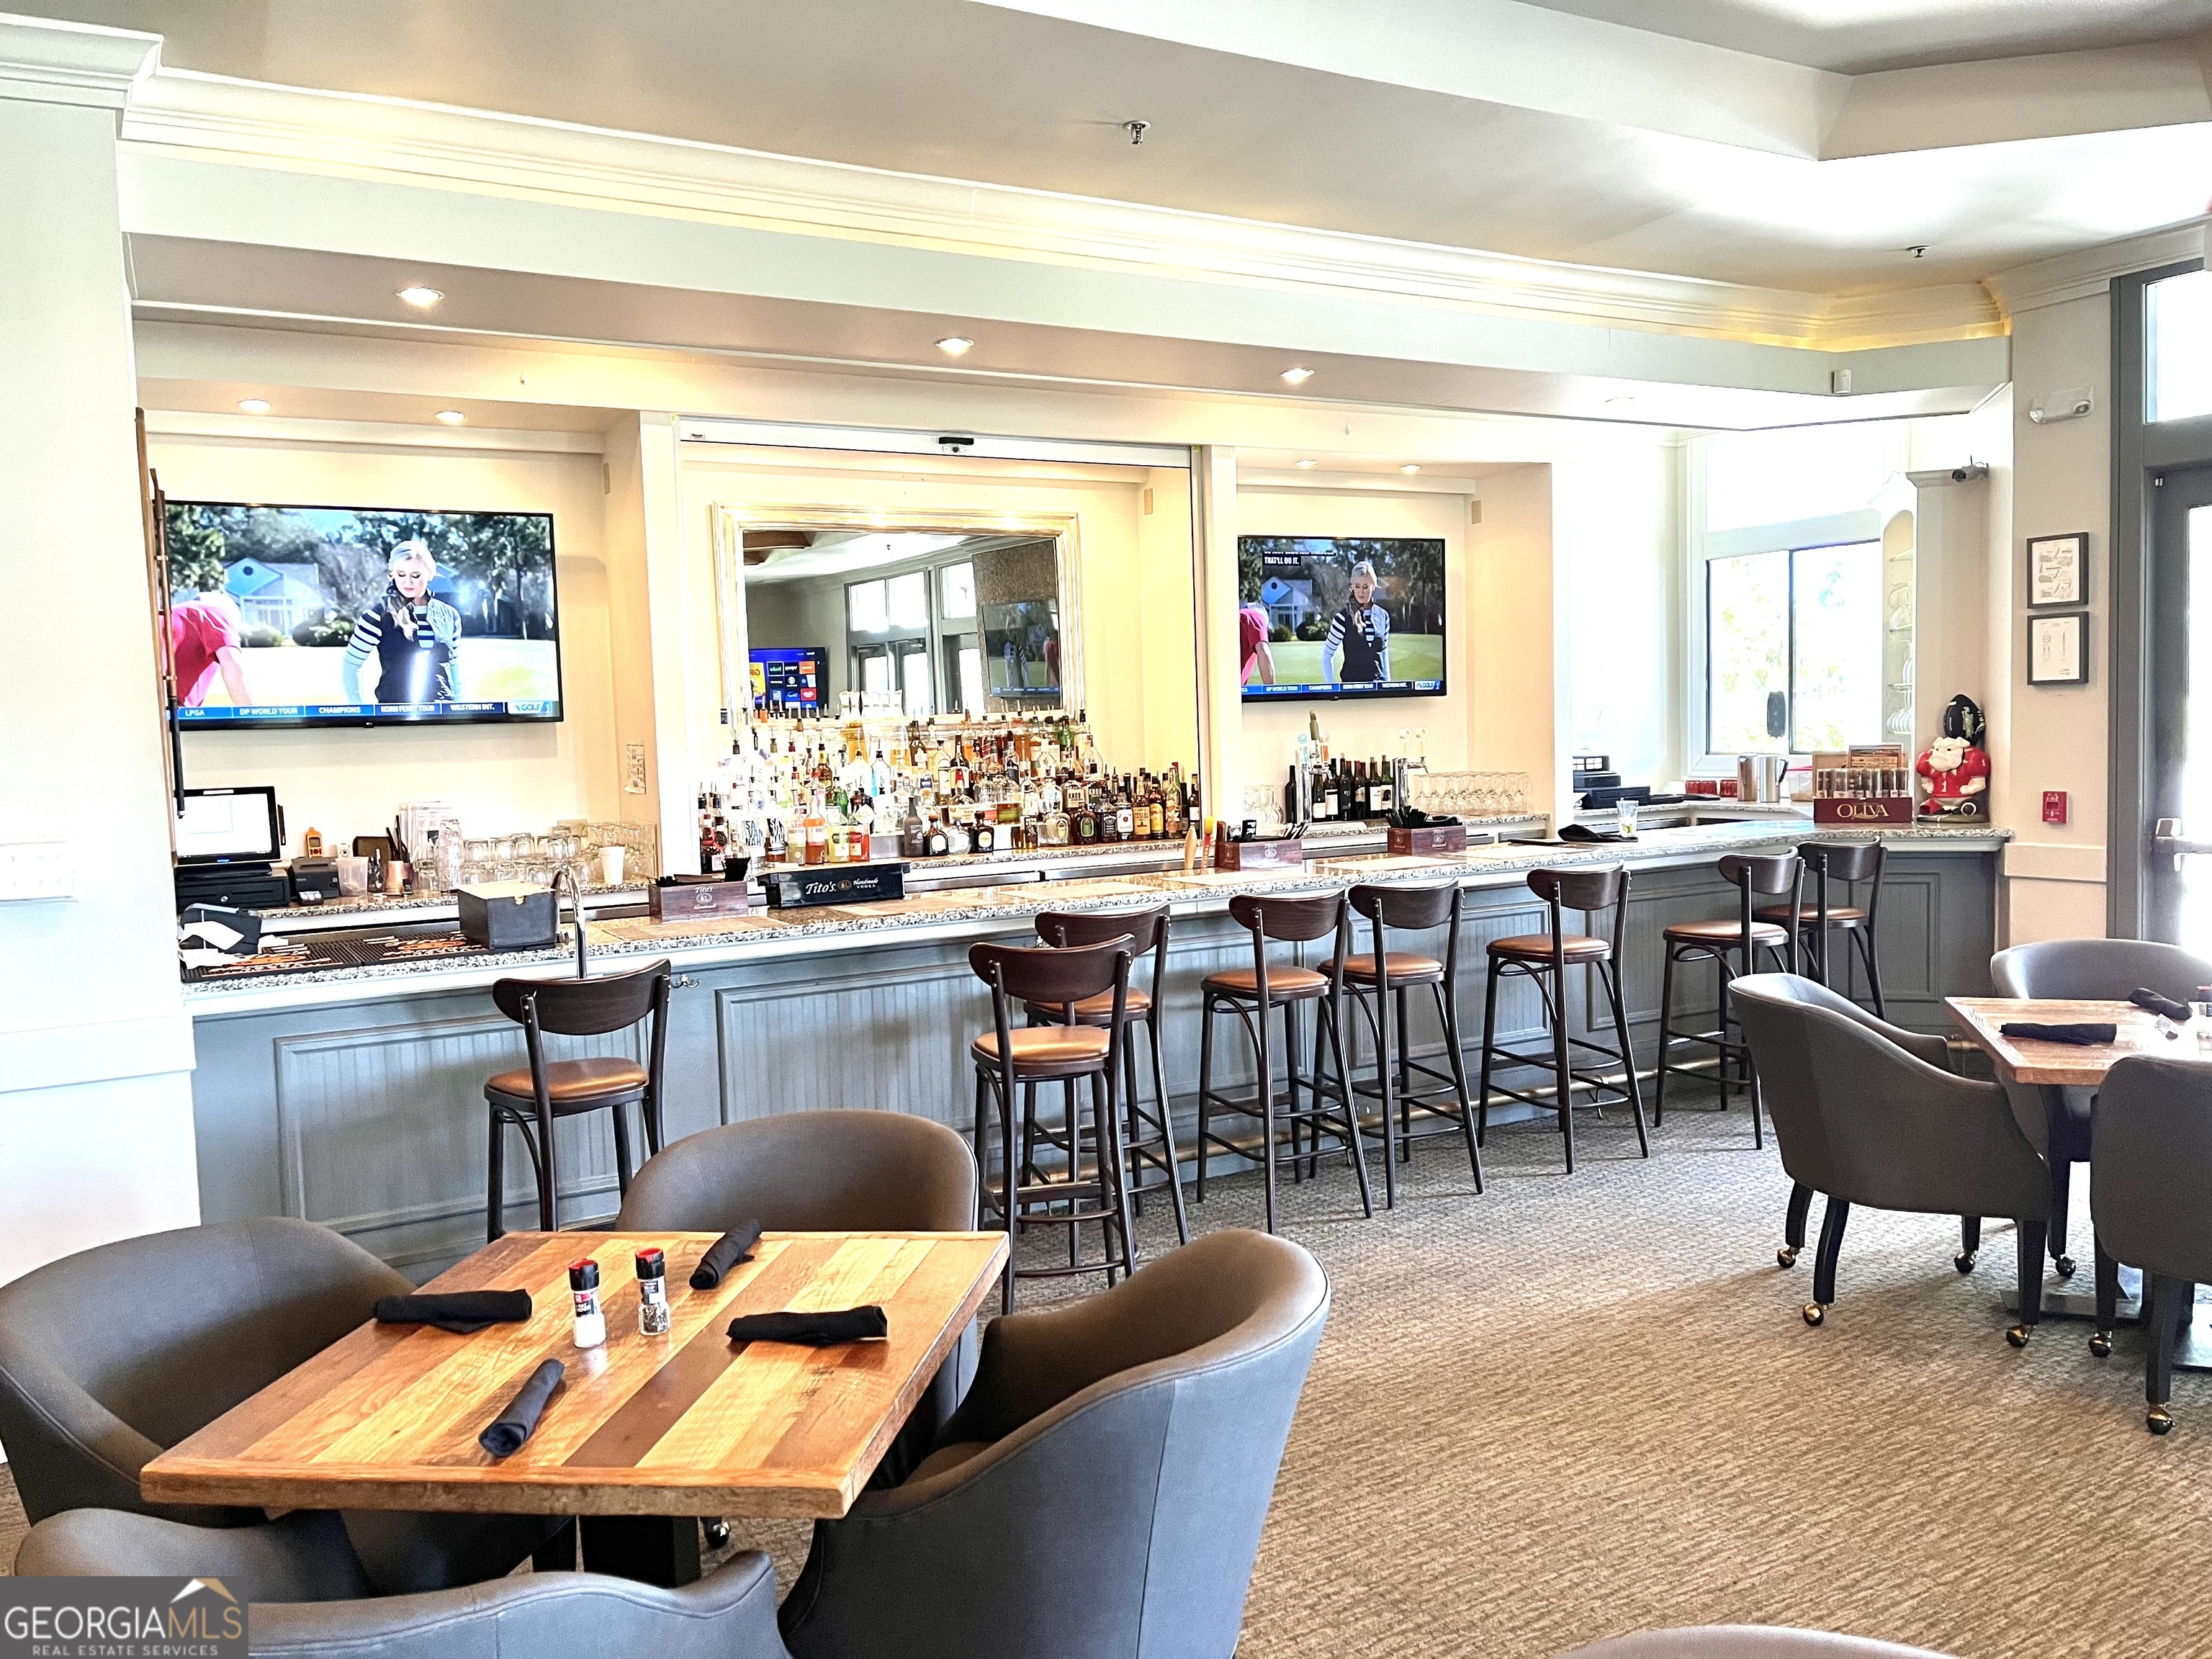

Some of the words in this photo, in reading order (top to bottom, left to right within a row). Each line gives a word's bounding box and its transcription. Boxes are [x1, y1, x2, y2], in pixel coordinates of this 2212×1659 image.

[251, 707, 278, 716] WORLD
[318, 706, 361, 714] CHAMPIONS
[1941, 781, 1947, 793] 1
[1837, 802, 1890, 818] OLIVA
[805, 881, 836, 895] Tito's
